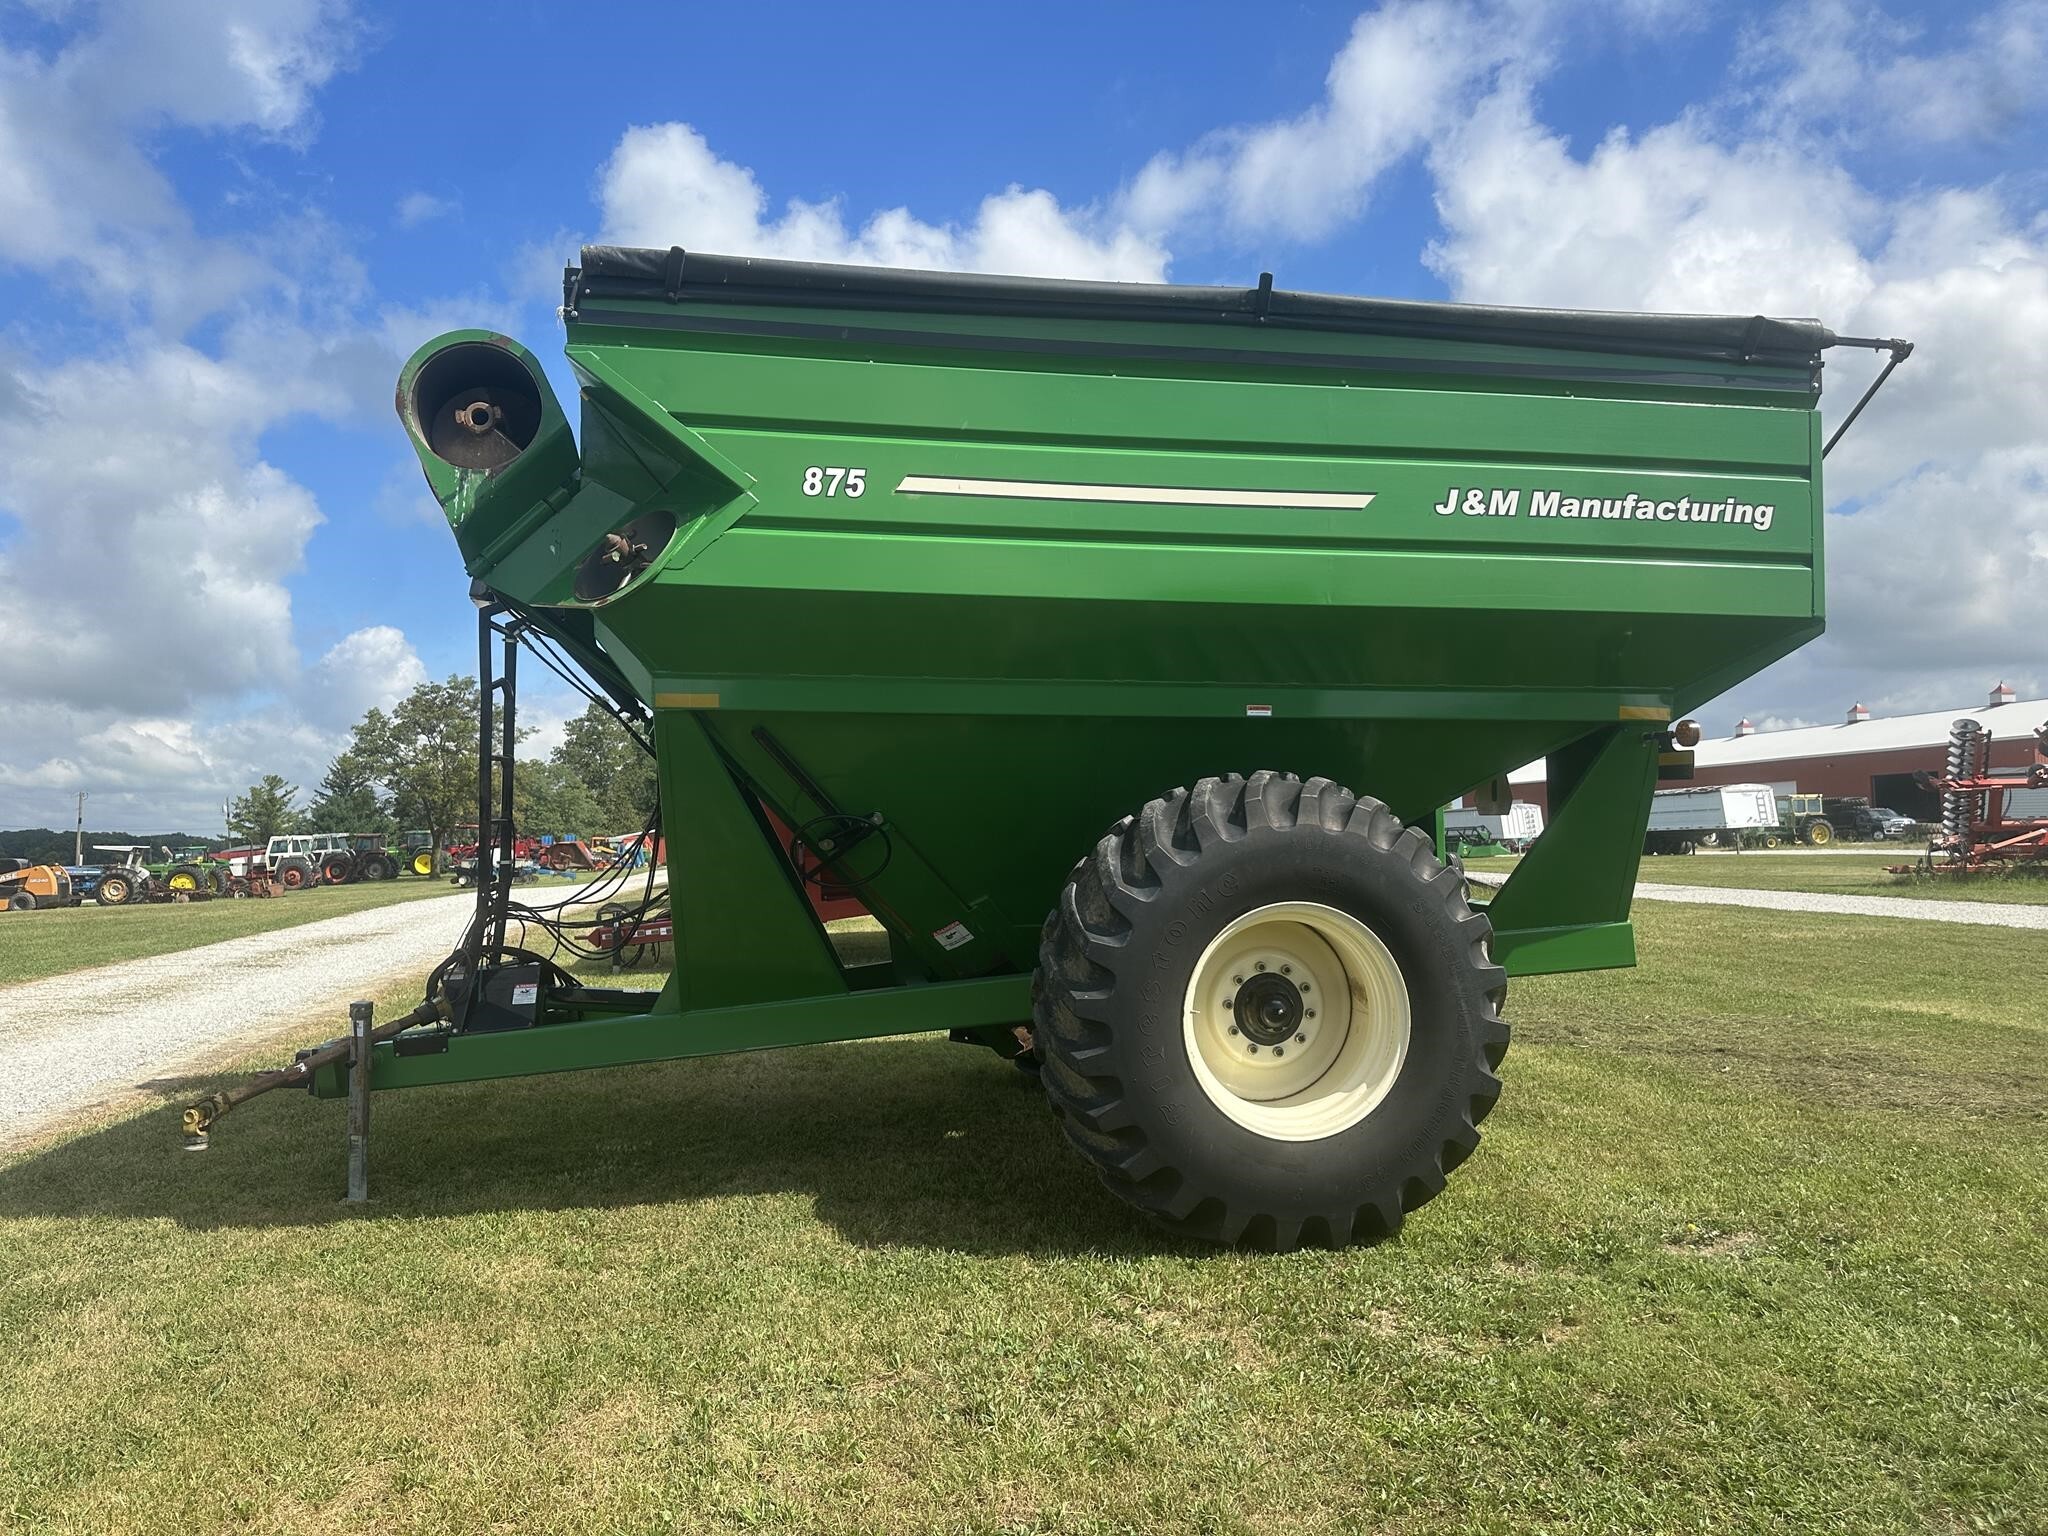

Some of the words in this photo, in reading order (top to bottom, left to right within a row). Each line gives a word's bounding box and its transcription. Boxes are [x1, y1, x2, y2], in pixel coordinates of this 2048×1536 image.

[801, 466, 867, 498] 875
[1434, 487, 1521, 517] J&M
[1528, 490, 1775, 530] Manufacturing
[1136, 872, 1240, 1127] Firestone
